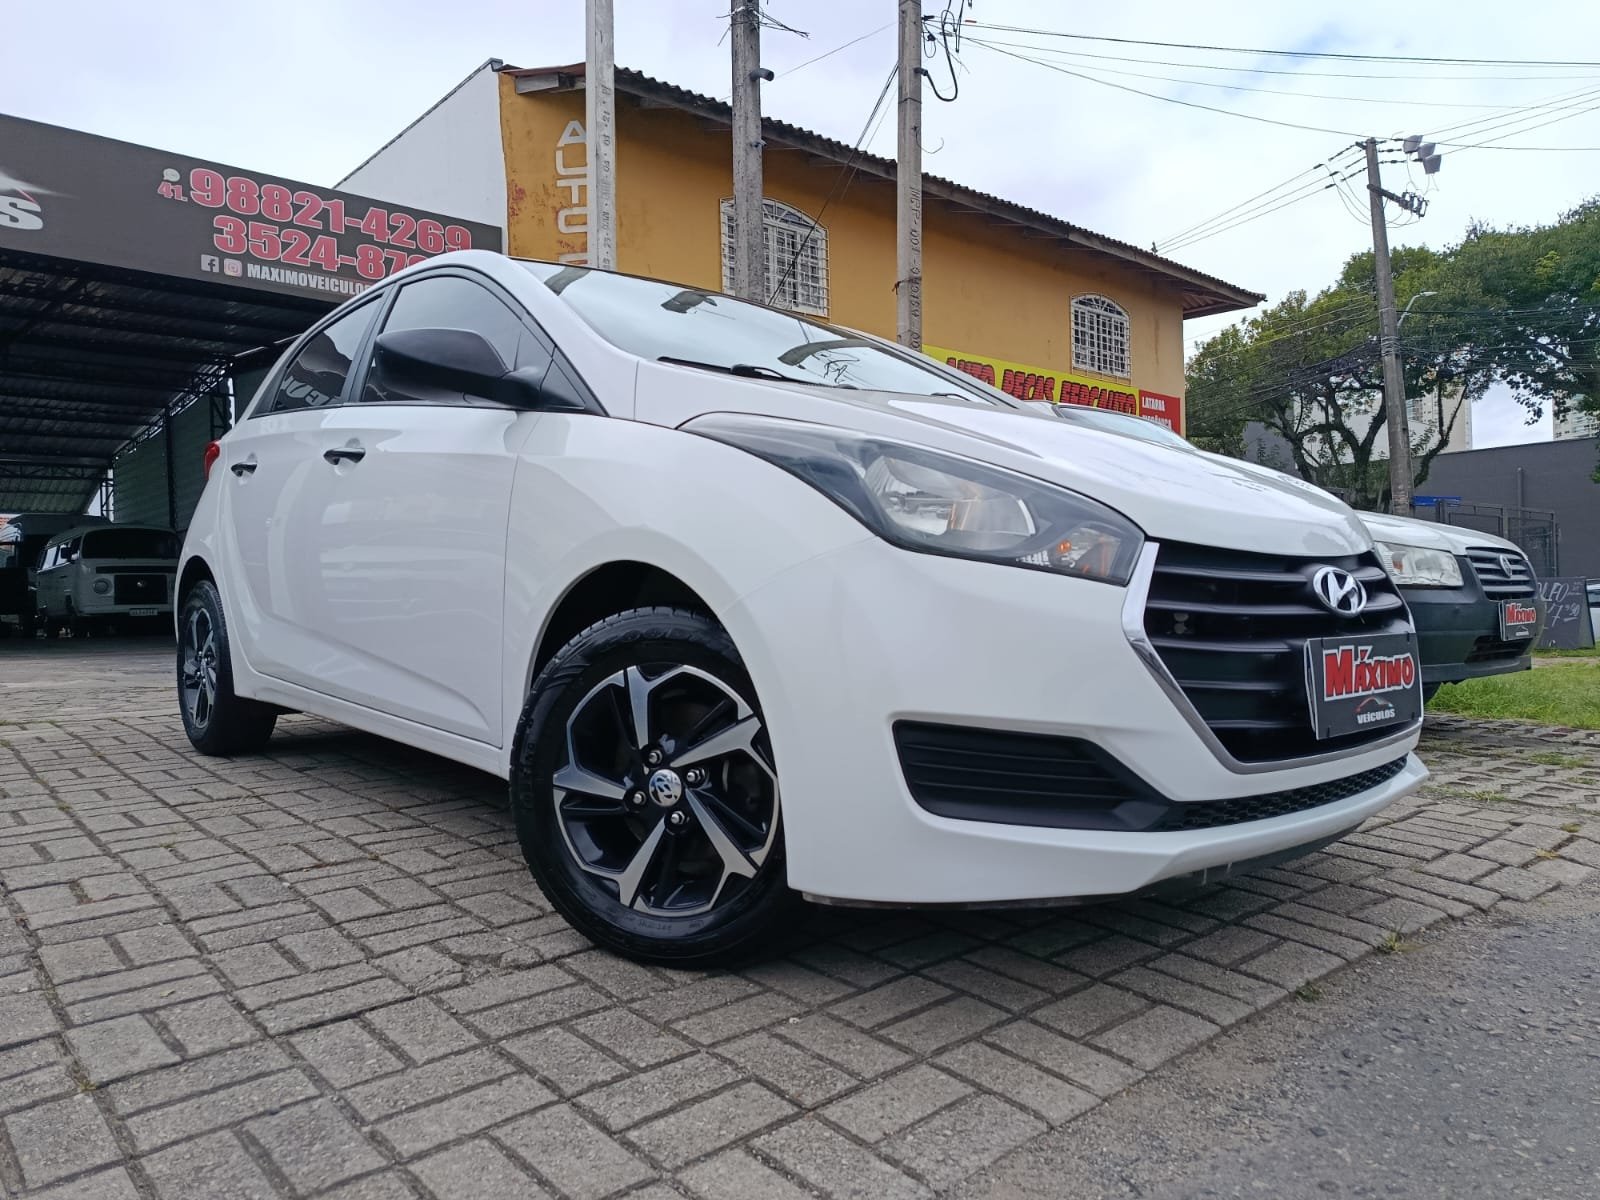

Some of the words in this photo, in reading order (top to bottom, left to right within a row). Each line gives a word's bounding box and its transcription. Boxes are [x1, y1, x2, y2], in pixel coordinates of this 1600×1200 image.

[190, 168, 472, 252] 98821-4269
[213, 215, 428, 280] 3524-87
[1323, 645, 1415, 701] MÁXIMO
